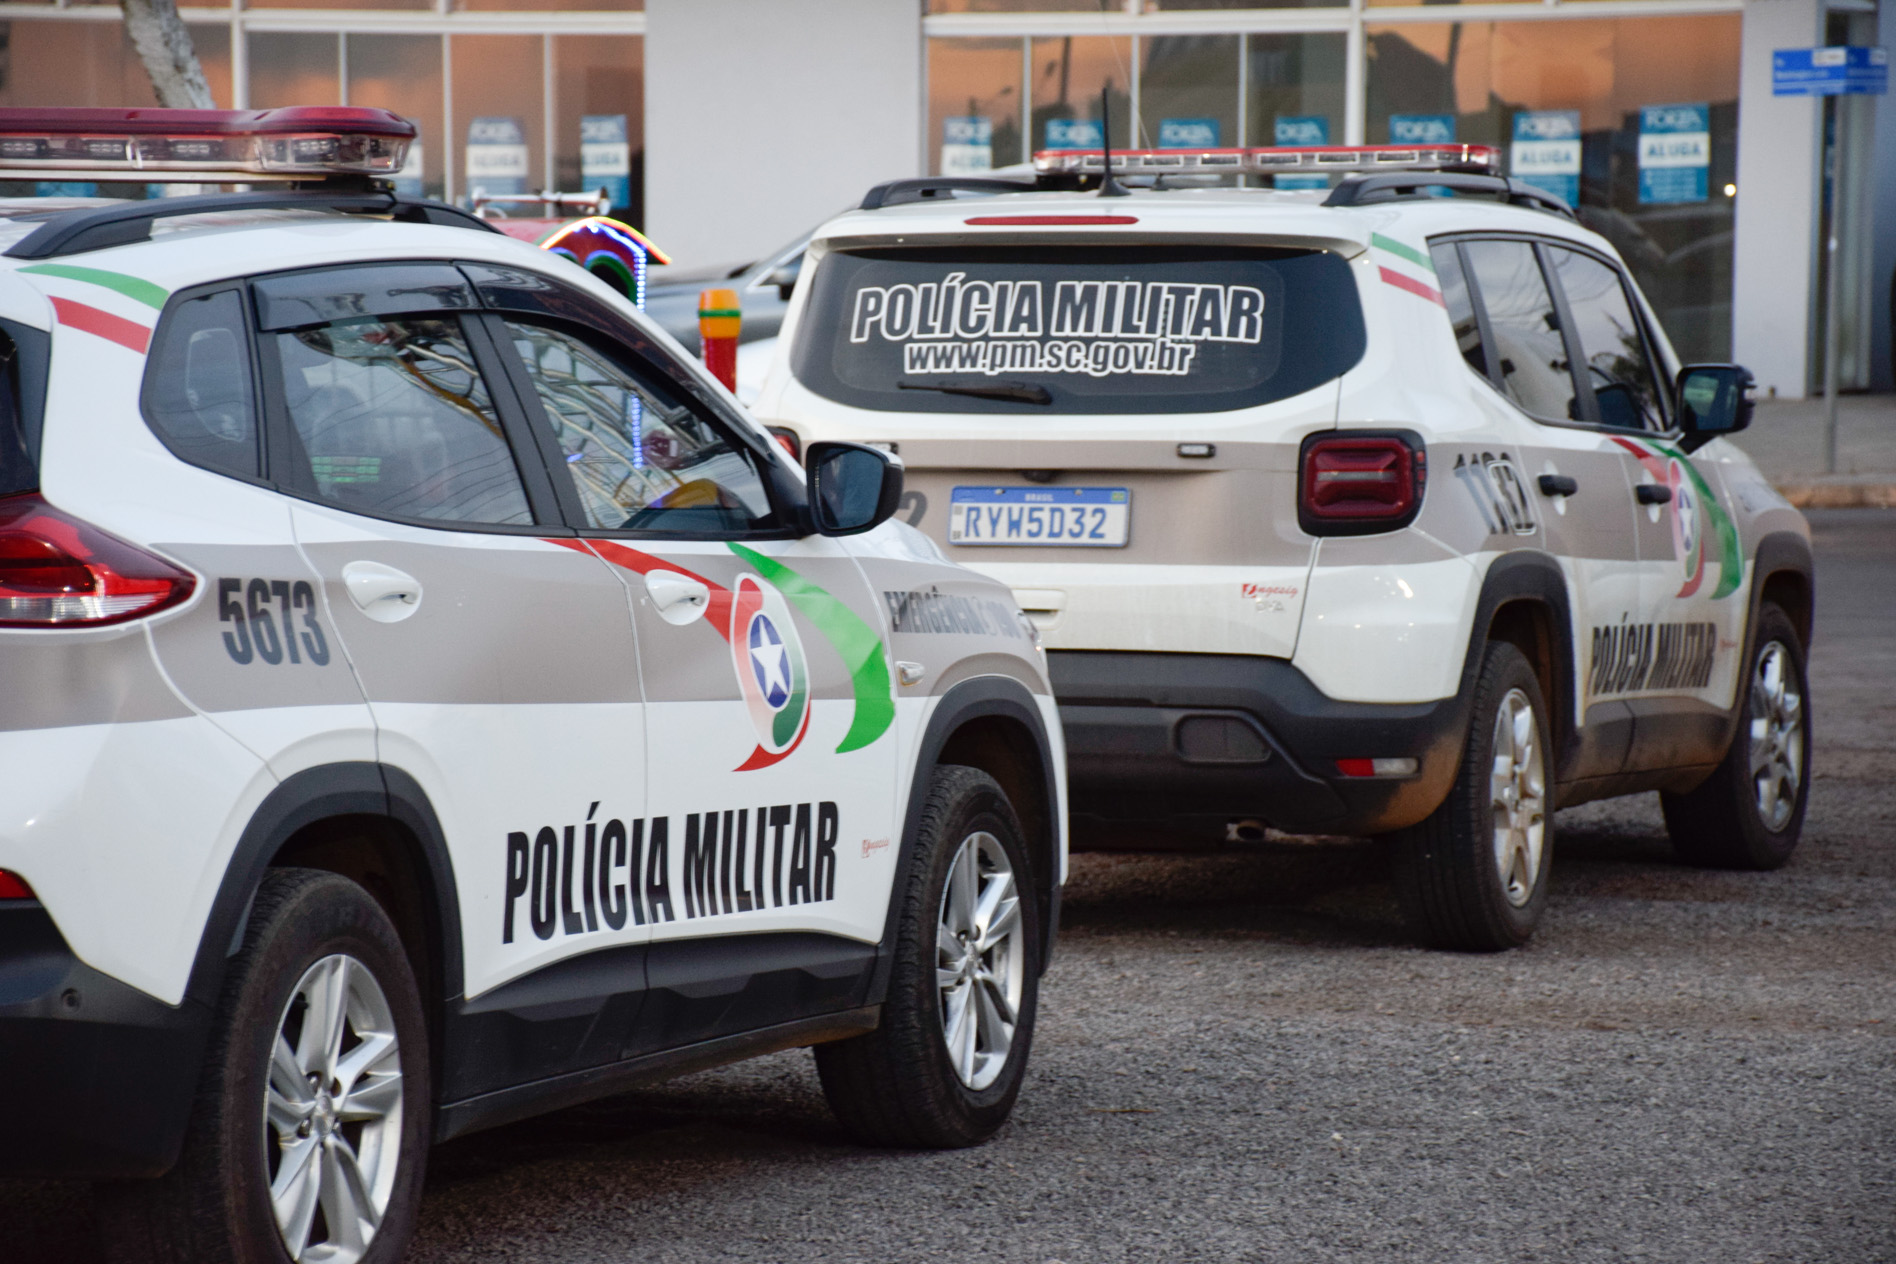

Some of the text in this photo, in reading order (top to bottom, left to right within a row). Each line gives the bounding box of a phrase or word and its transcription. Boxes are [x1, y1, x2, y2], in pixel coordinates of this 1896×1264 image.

[850, 272, 1265, 343] POLÍCIA MILITAR
[904, 339, 1196, 376] www.pm.sc.gov.br
[965, 506, 1107, 539] RYW5D32
[218, 577, 331, 666] 5673
[1591, 611, 1716, 696] POLÍCIA MILITAR
[502, 801, 839, 945] POLÍCIA MILITAR
